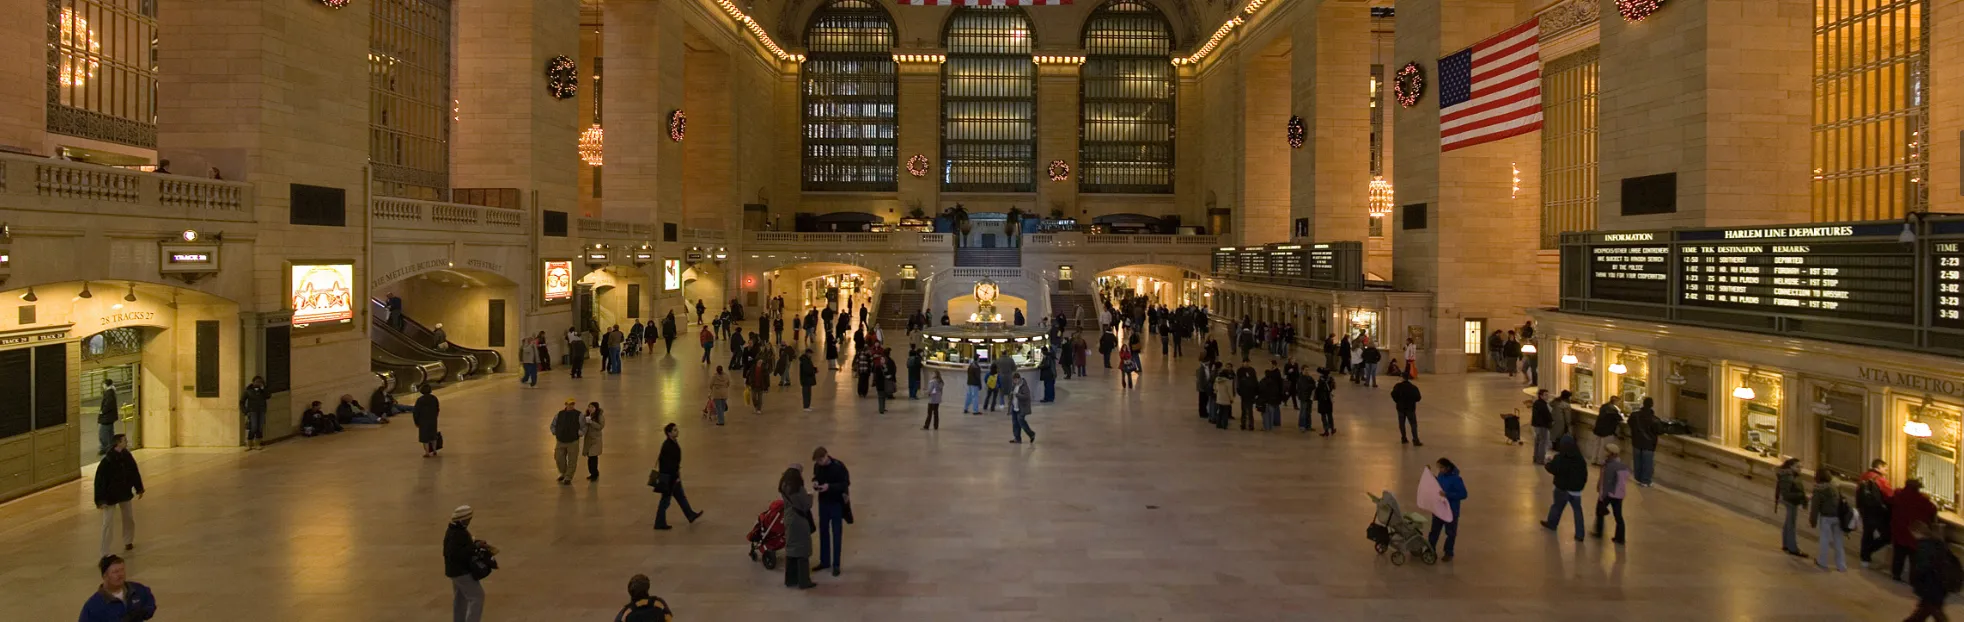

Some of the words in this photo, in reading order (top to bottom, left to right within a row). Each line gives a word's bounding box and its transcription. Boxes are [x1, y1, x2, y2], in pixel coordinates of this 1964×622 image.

[1725, 229, 1763, 239] HARLEM
[1764, 228, 1786, 238] LINE
[1789, 226, 1853, 237] DEPARTURES
[1605, 233, 1653, 241] INFORMATION
[418, 258, 449, 272] BUILDING
[1940, 258, 1959, 266] 2:23
[1940, 271, 1959, 279] 2:50
[1823, 279, 1838, 287] STOP
[1940, 284, 1959, 292] 3:02
[1822, 301, 1838, 309] STOP
[1940, 297, 1959, 306] 3:23
[1940, 309, 1959, 319] 3:50
[100, 316, 110, 326] 28
[112, 311, 144, 323] TRACKS
[145, 312, 154, 320] 27
[1858, 366, 1891, 385] MTA
[1896, 372, 1964, 395] METRO-
